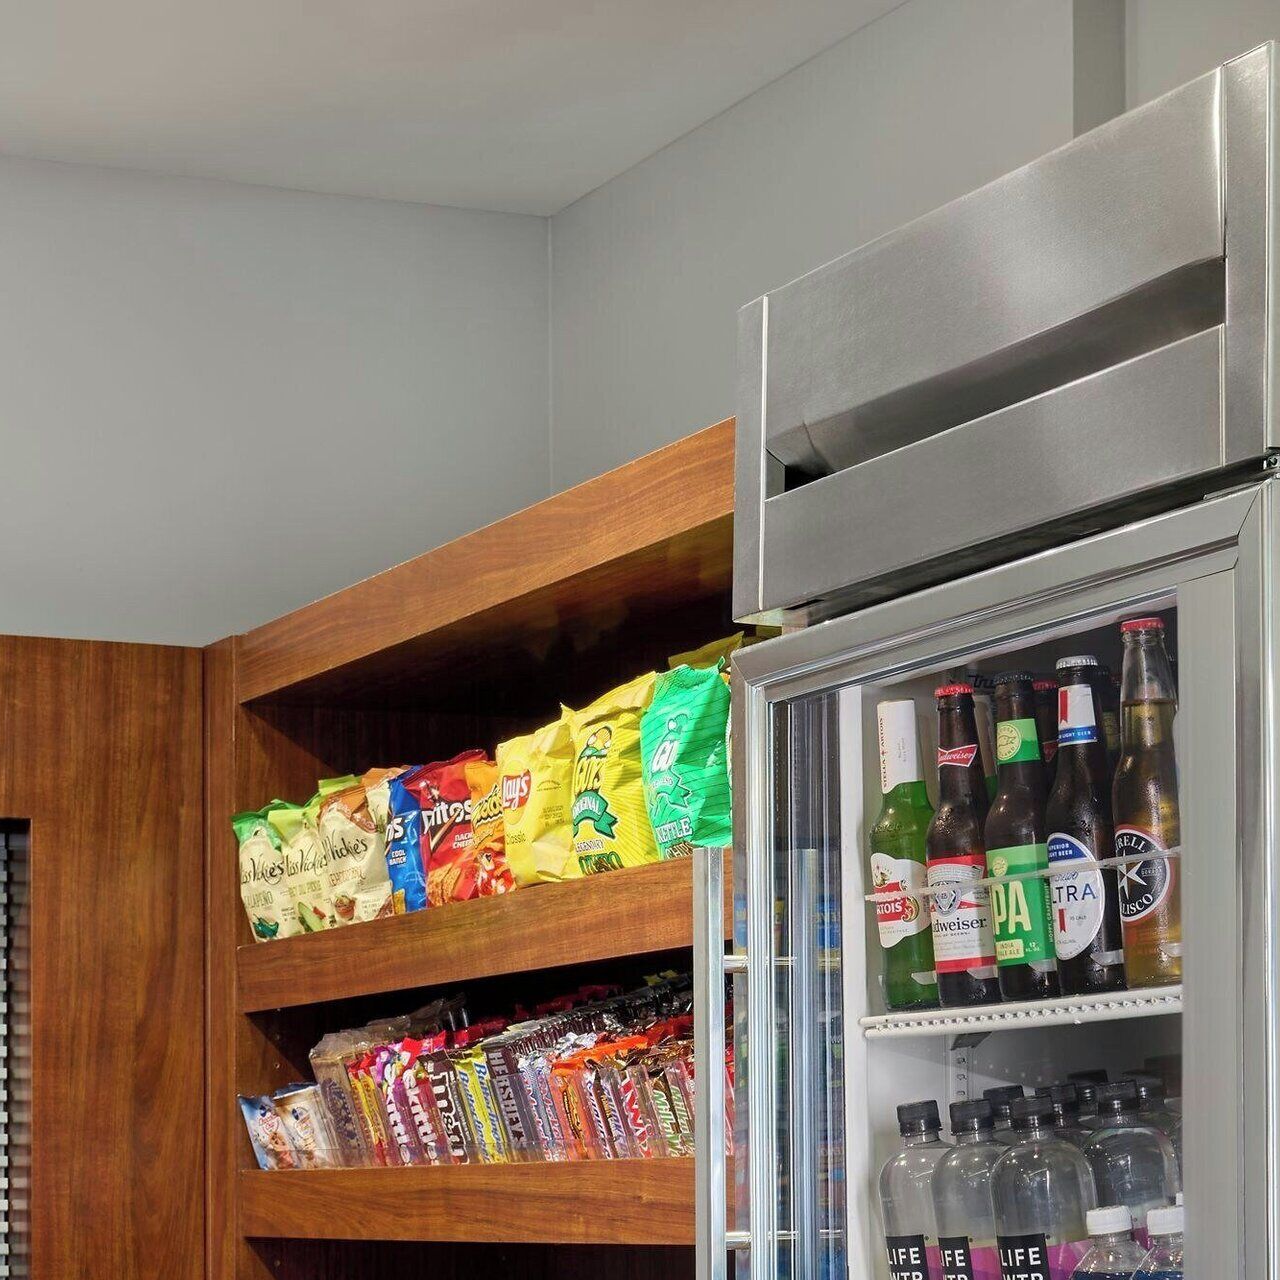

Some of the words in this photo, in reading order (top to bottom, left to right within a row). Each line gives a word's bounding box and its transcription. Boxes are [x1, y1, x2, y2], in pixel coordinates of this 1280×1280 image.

[502, 770, 531, 810] Lay's
[989, 880, 1033, 936] PA
[886, 1247, 922, 1266] LIFE
[1000, 1246, 1042, 1267] LIFE
